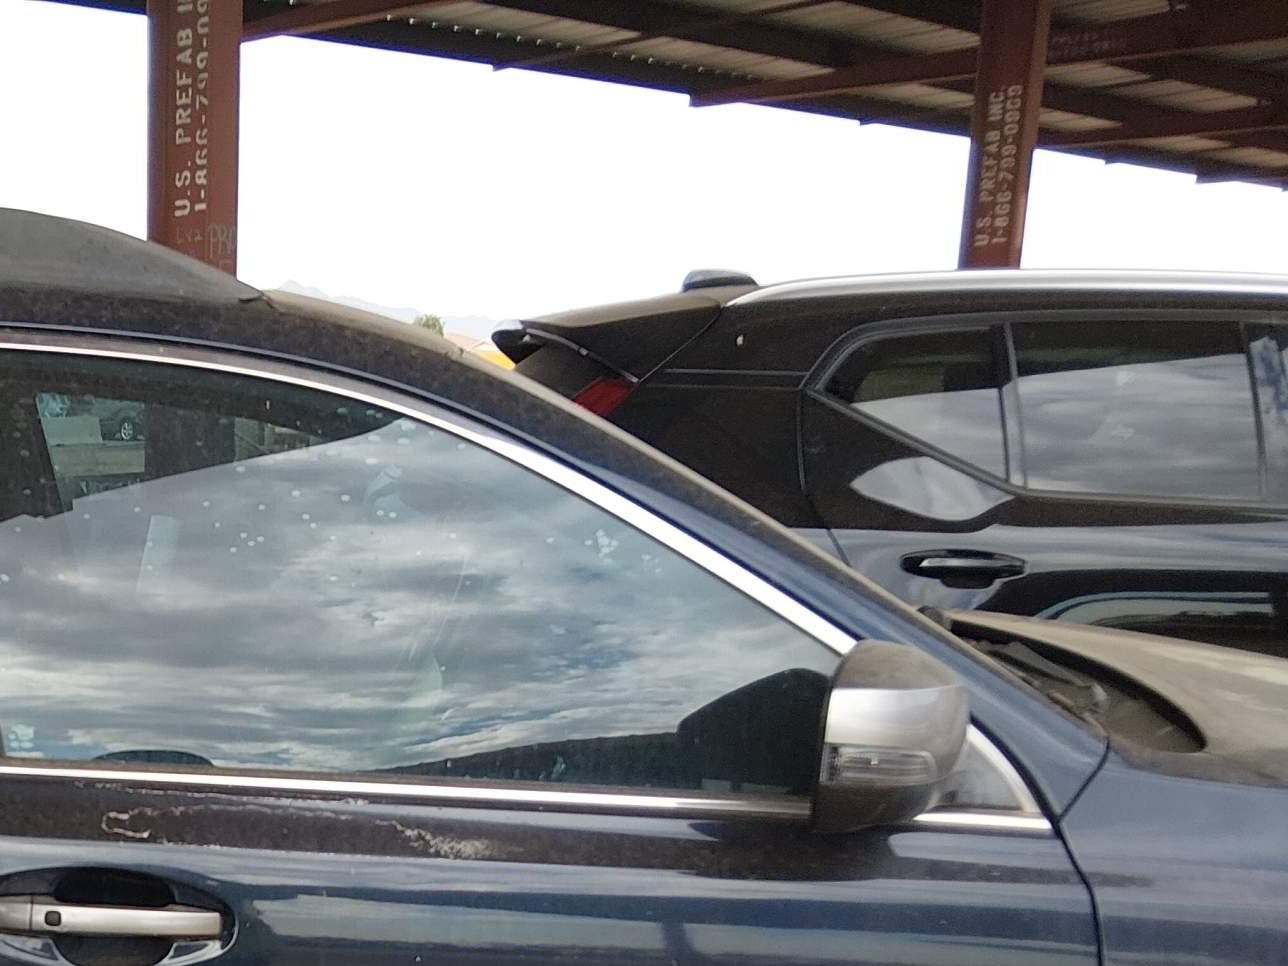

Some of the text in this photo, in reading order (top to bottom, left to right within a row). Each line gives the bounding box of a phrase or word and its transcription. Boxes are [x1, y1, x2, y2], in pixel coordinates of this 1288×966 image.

[175, 28, 192, 145] PREFAB
[174, 160, 191, 217] U.S.
[979, 130, 1001, 201] PREFAB
[974, 210, 993, 246] U.S.
